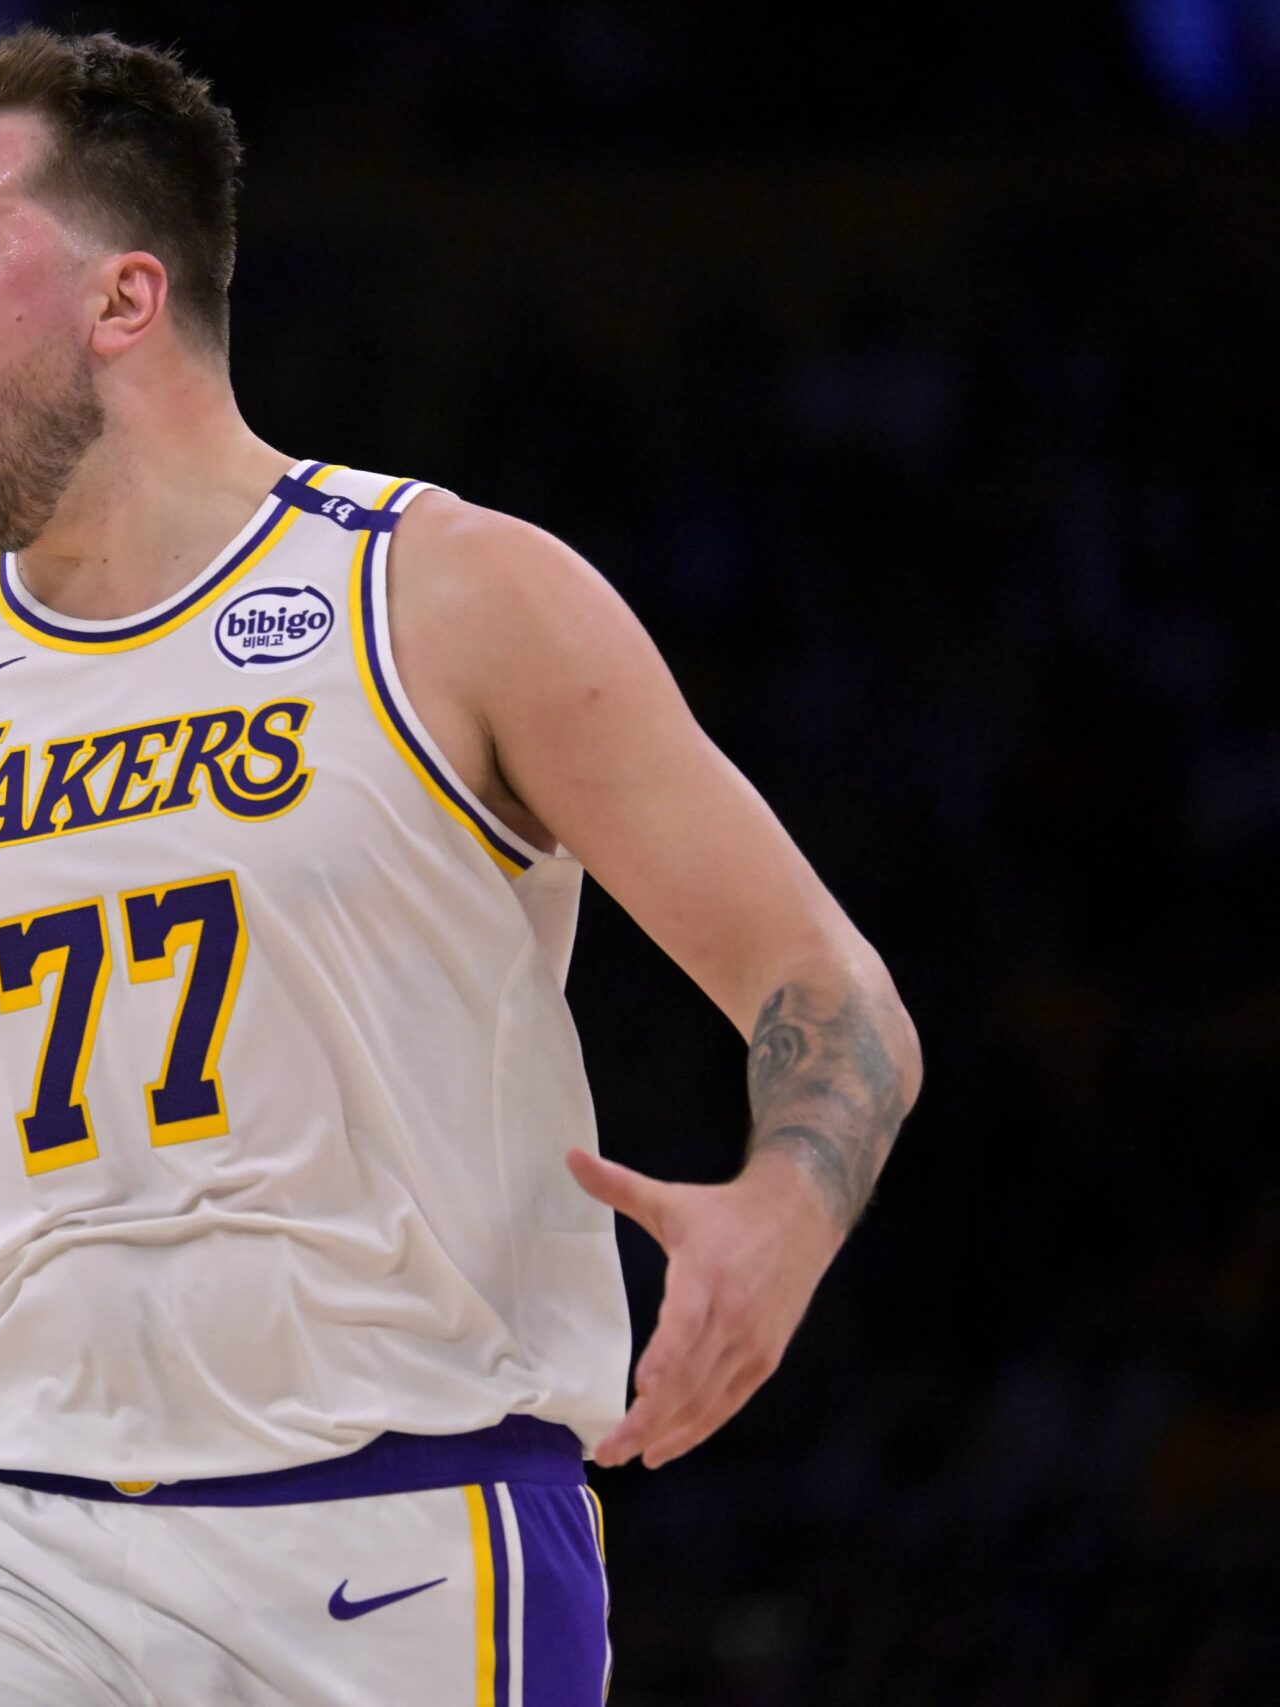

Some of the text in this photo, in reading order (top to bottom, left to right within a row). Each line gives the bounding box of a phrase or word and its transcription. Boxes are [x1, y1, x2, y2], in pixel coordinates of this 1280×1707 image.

[321, 498, 356, 523] 44
[227, 606, 328, 640] bibigo
[242, 633, 284, 649] 비비고
